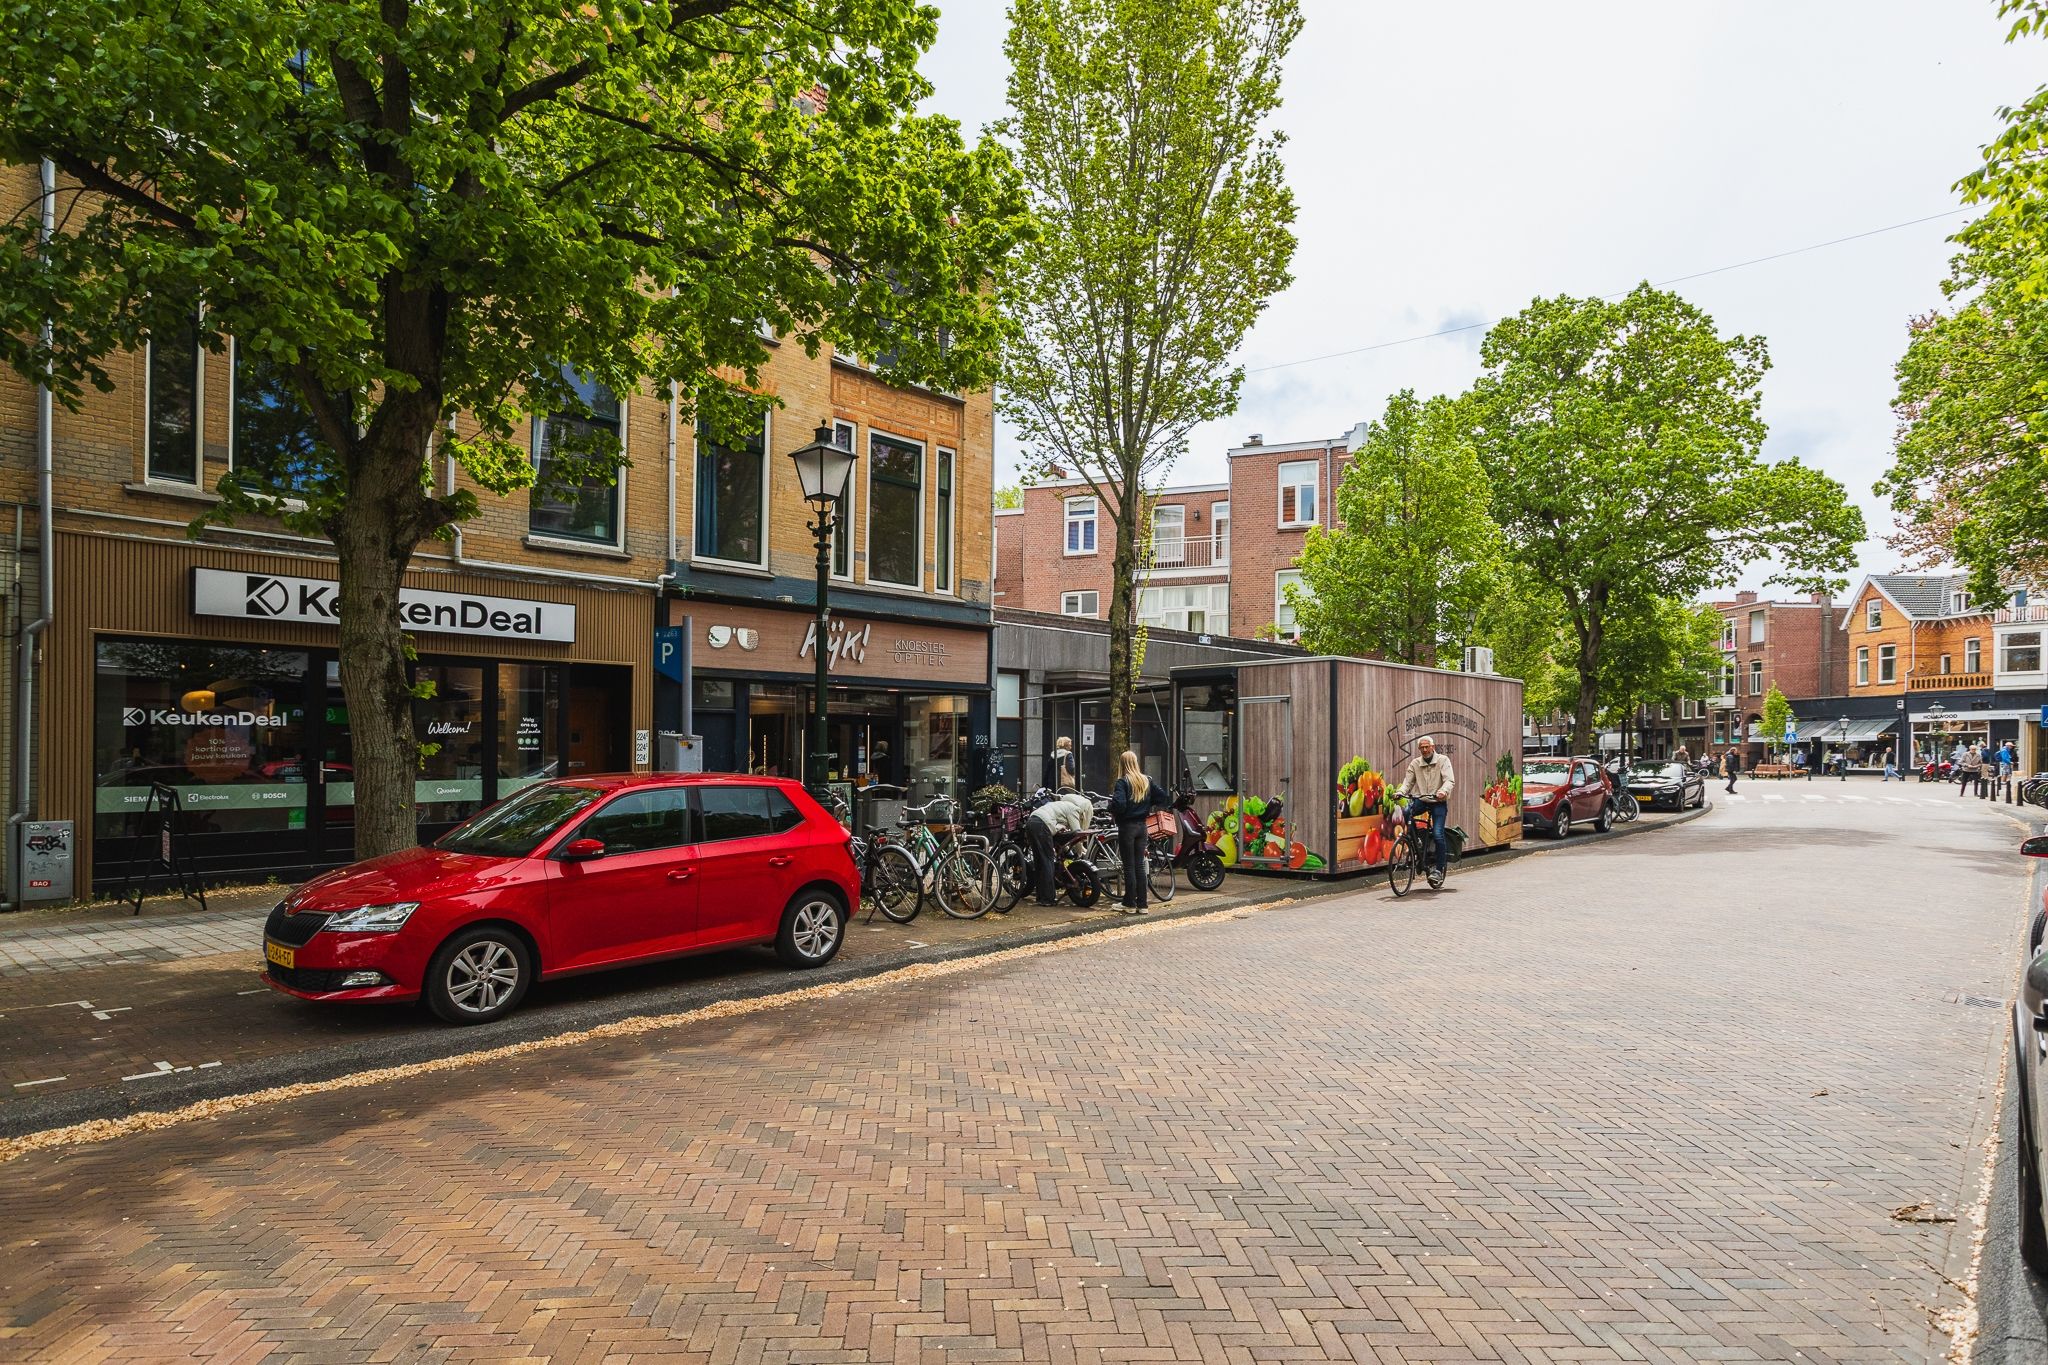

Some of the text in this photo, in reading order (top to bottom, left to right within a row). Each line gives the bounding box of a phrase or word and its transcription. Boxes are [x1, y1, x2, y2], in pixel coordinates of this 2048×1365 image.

[299, 584, 542, 635] KeenDeal
[662, 642, 674, 664] P
[895, 639, 945, 653] KNOESTER
[894, 652, 945, 666] OPTIEK
[150, 709, 287, 727] KeukenDeal
[1405, 714, 1422, 732] BRAND
[1423, 712, 1443, 725] GROENTE
[428, 721, 471, 734] Welkom!
[191, 753, 214, 761] jouw
